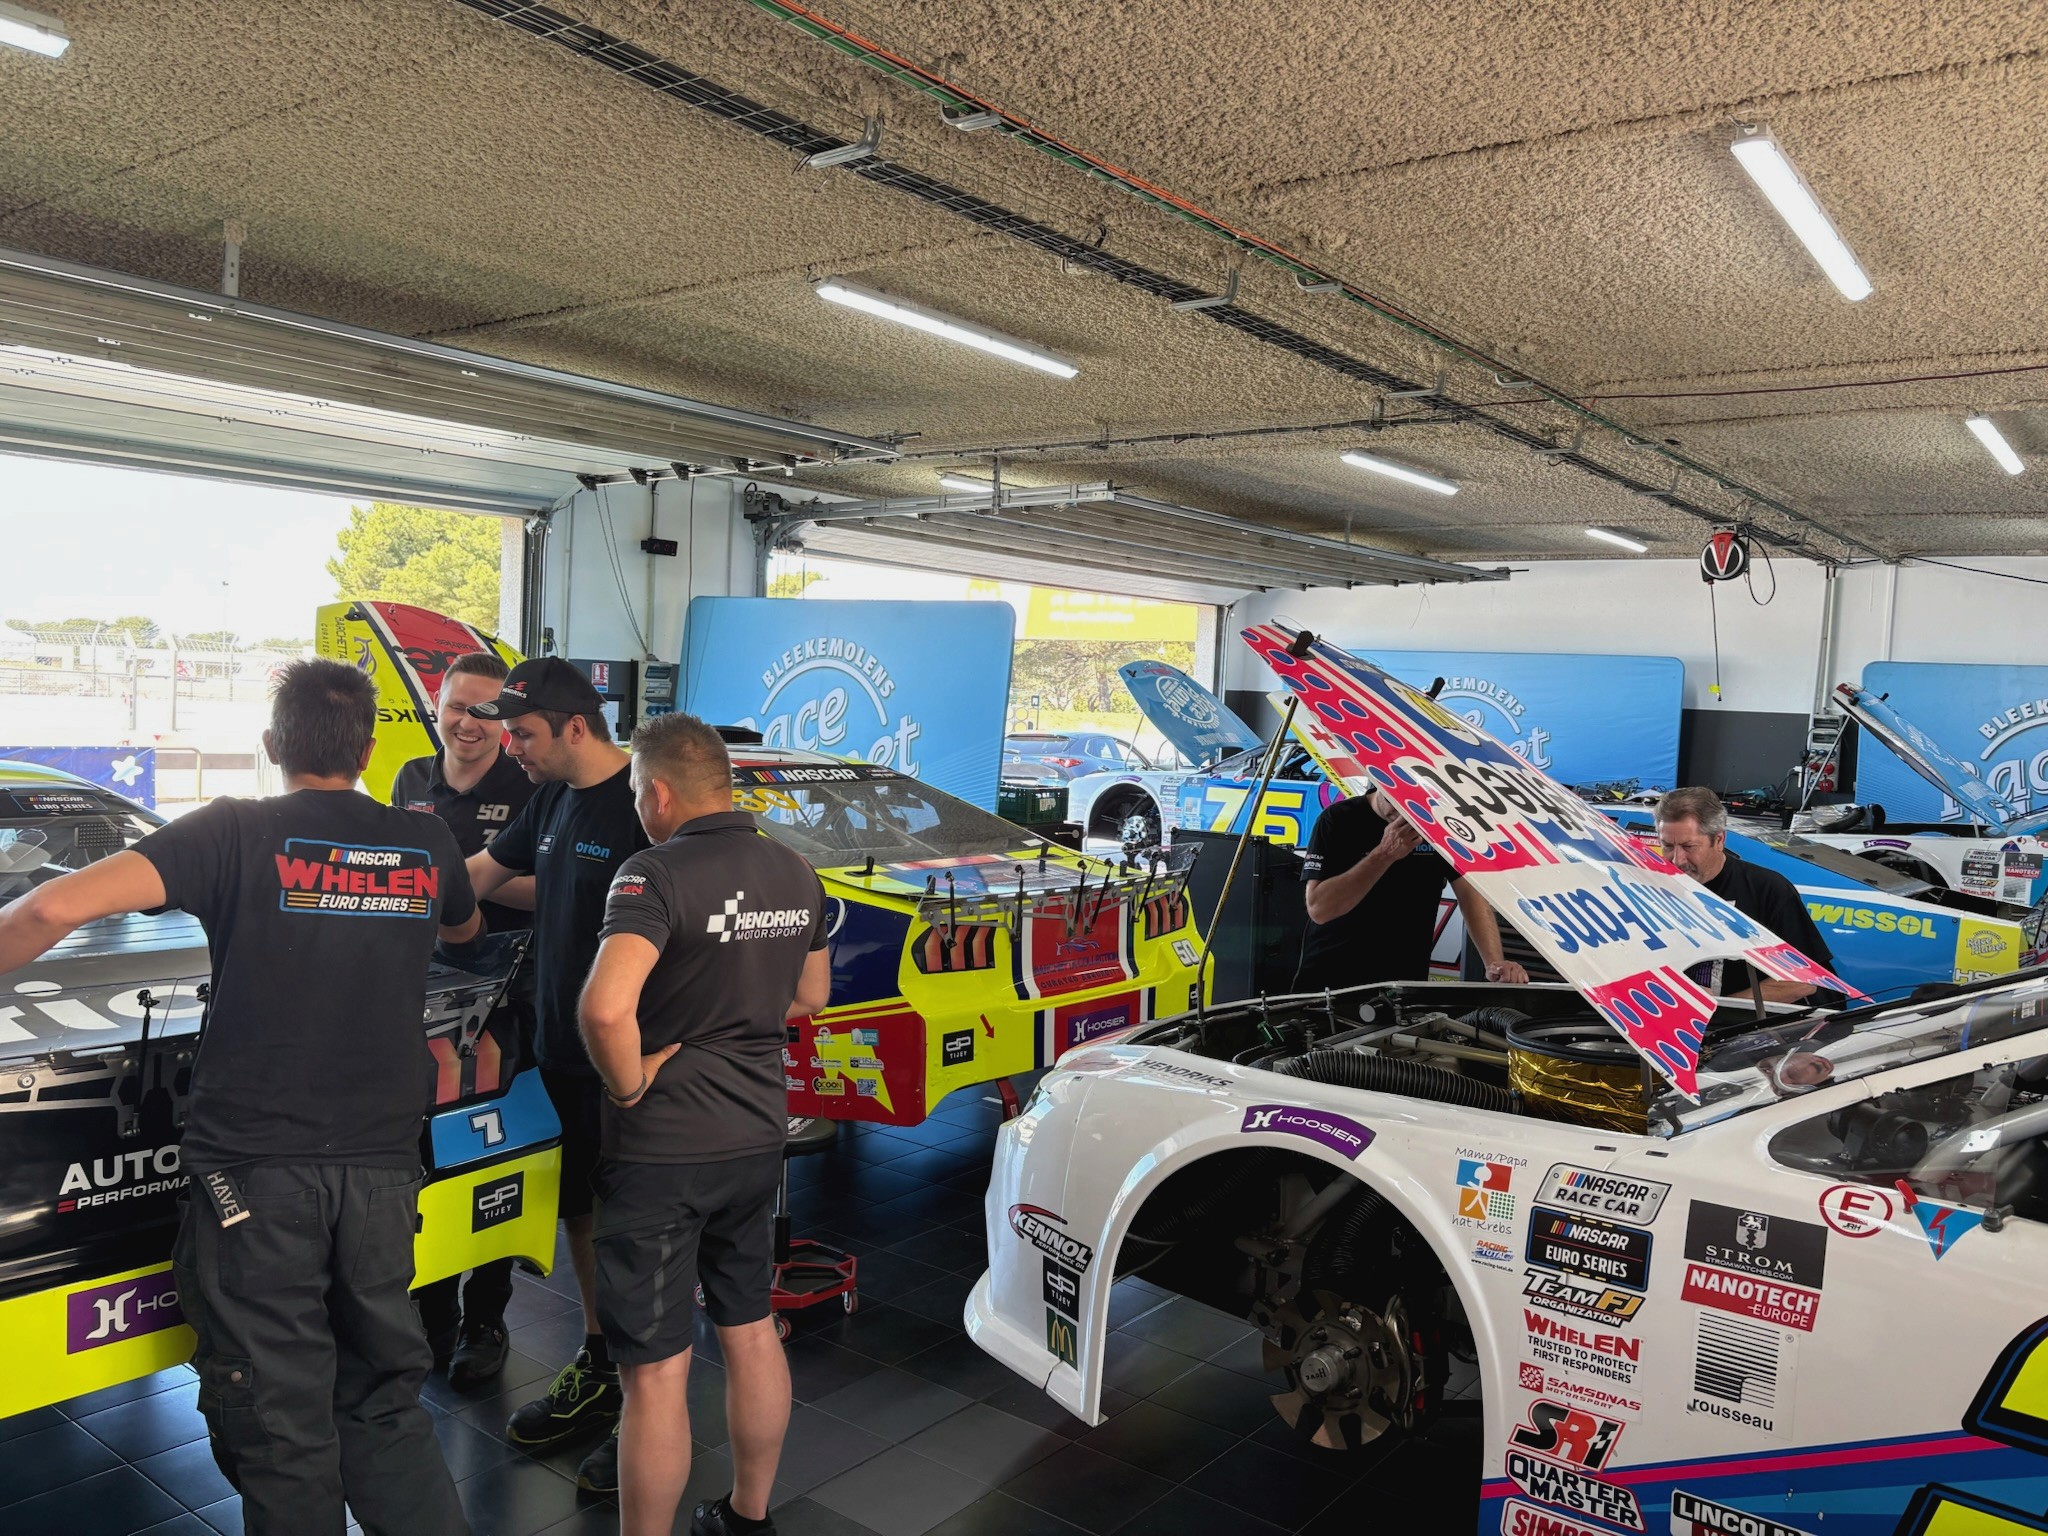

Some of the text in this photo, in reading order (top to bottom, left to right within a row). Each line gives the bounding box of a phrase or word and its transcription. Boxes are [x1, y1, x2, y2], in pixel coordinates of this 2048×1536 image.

[761, 637, 896, 698] BLEEKEMOLENS
[777, 768, 860, 783] NASCAR
[347, 851, 402, 866] NASCAR
[576, 840, 611, 858] orion
[275, 853, 439, 899] WHELEN
[318, 894, 409, 912] EURO SERIES
[734, 909, 810, 931] HENDRIKS
[735, 927, 803, 941] MOTORSPORT
[1806, 902, 1937, 939] WISSOL
[1171, 938, 1200, 968] 50
[1087, 1015, 1126, 1033] HOOSIER
[1138, 1059, 1235, 1088] HENDRIKS
[1277, 1114, 1362, 1148] HOOSIER
[1454, 1146, 1528, 1170] Mama/Papa
[1555, 1188, 1640, 1216] RACE CAR
[1581, 1174, 1650, 1202] NASCAR
[484, 1203, 512, 1220] TIJEY
[1451, 1214, 1513, 1235] hat Krebs
[1012, 1209, 1088, 1265] KENNOL
[1477, 1240, 1509, 1253] RACING
[1568, 1223, 1629, 1251] NASCAR
[1035, 1239, 1086, 1271] PERFORMANCE OIL
[1471, 1258, 1514, 1273] www.racing-total.de
[1545, 1244, 1628, 1278] EURO SERIES
[1704, 1256, 1794, 1282] STROMWATCHES.COM
[1706, 1244, 1795, 1275] STROM
[1051, 1289, 1071, 1308] TIJEY
[1689, 1268, 1813, 1315] NANOTECH
[1533, 1295, 1622, 1326] ORGANIZATION
[1523, 1308, 1640, 1362] WHELEN
[1527, 1334, 1638, 1374] TRUSTED TO PROTECT
[1533, 1348, 1632, 1384] FIRST RESPONDERS
[1545, 1385, 1614, 1410] MOTORSPORT
[1547, 1376, 1642, 1412] SAMSONAS
[1692, 1398, 1773, 1432] rousseau
[1509, 1454, 1632, 1509] QUARTER
[1529, 1477, 1638, 1528] MASTER
